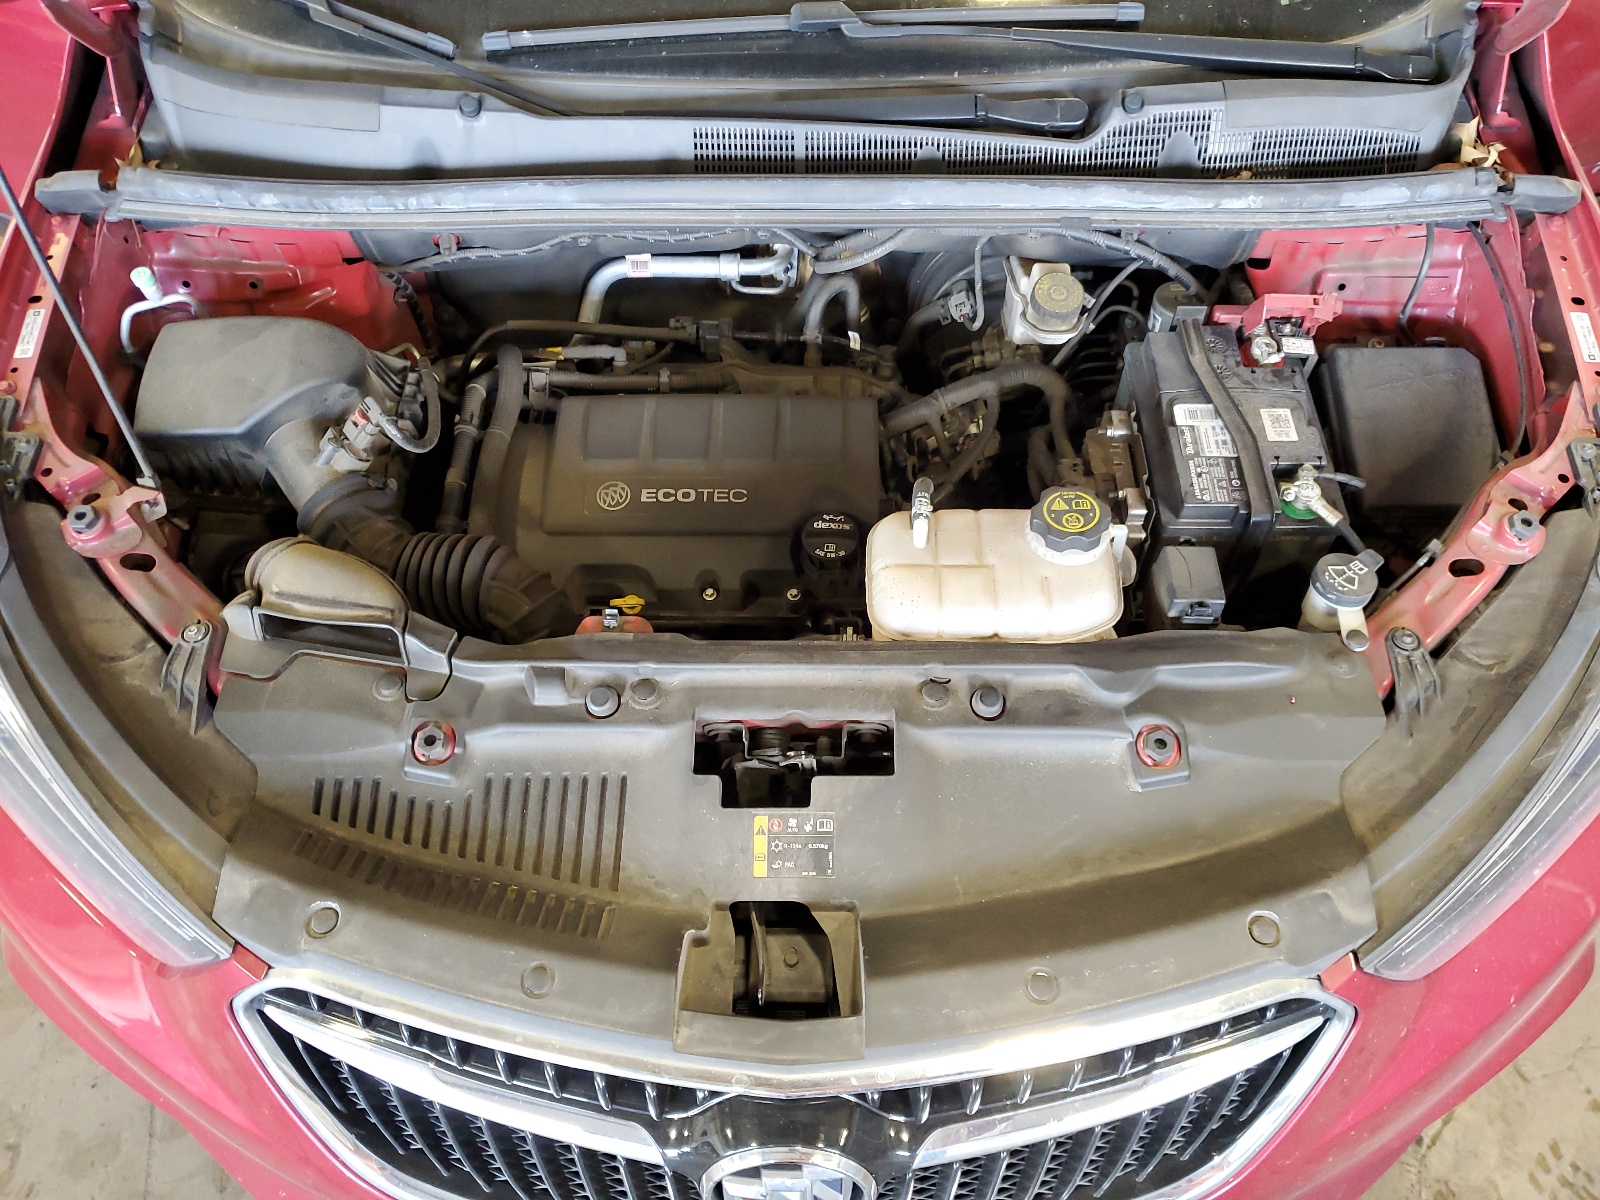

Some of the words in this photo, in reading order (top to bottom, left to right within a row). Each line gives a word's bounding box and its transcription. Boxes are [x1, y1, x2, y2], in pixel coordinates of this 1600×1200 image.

[1181, 426, 1195, 455] Duralast
[640, 488, 748, 503] ECOTEC
[813, 520, 850, 530] dexos
